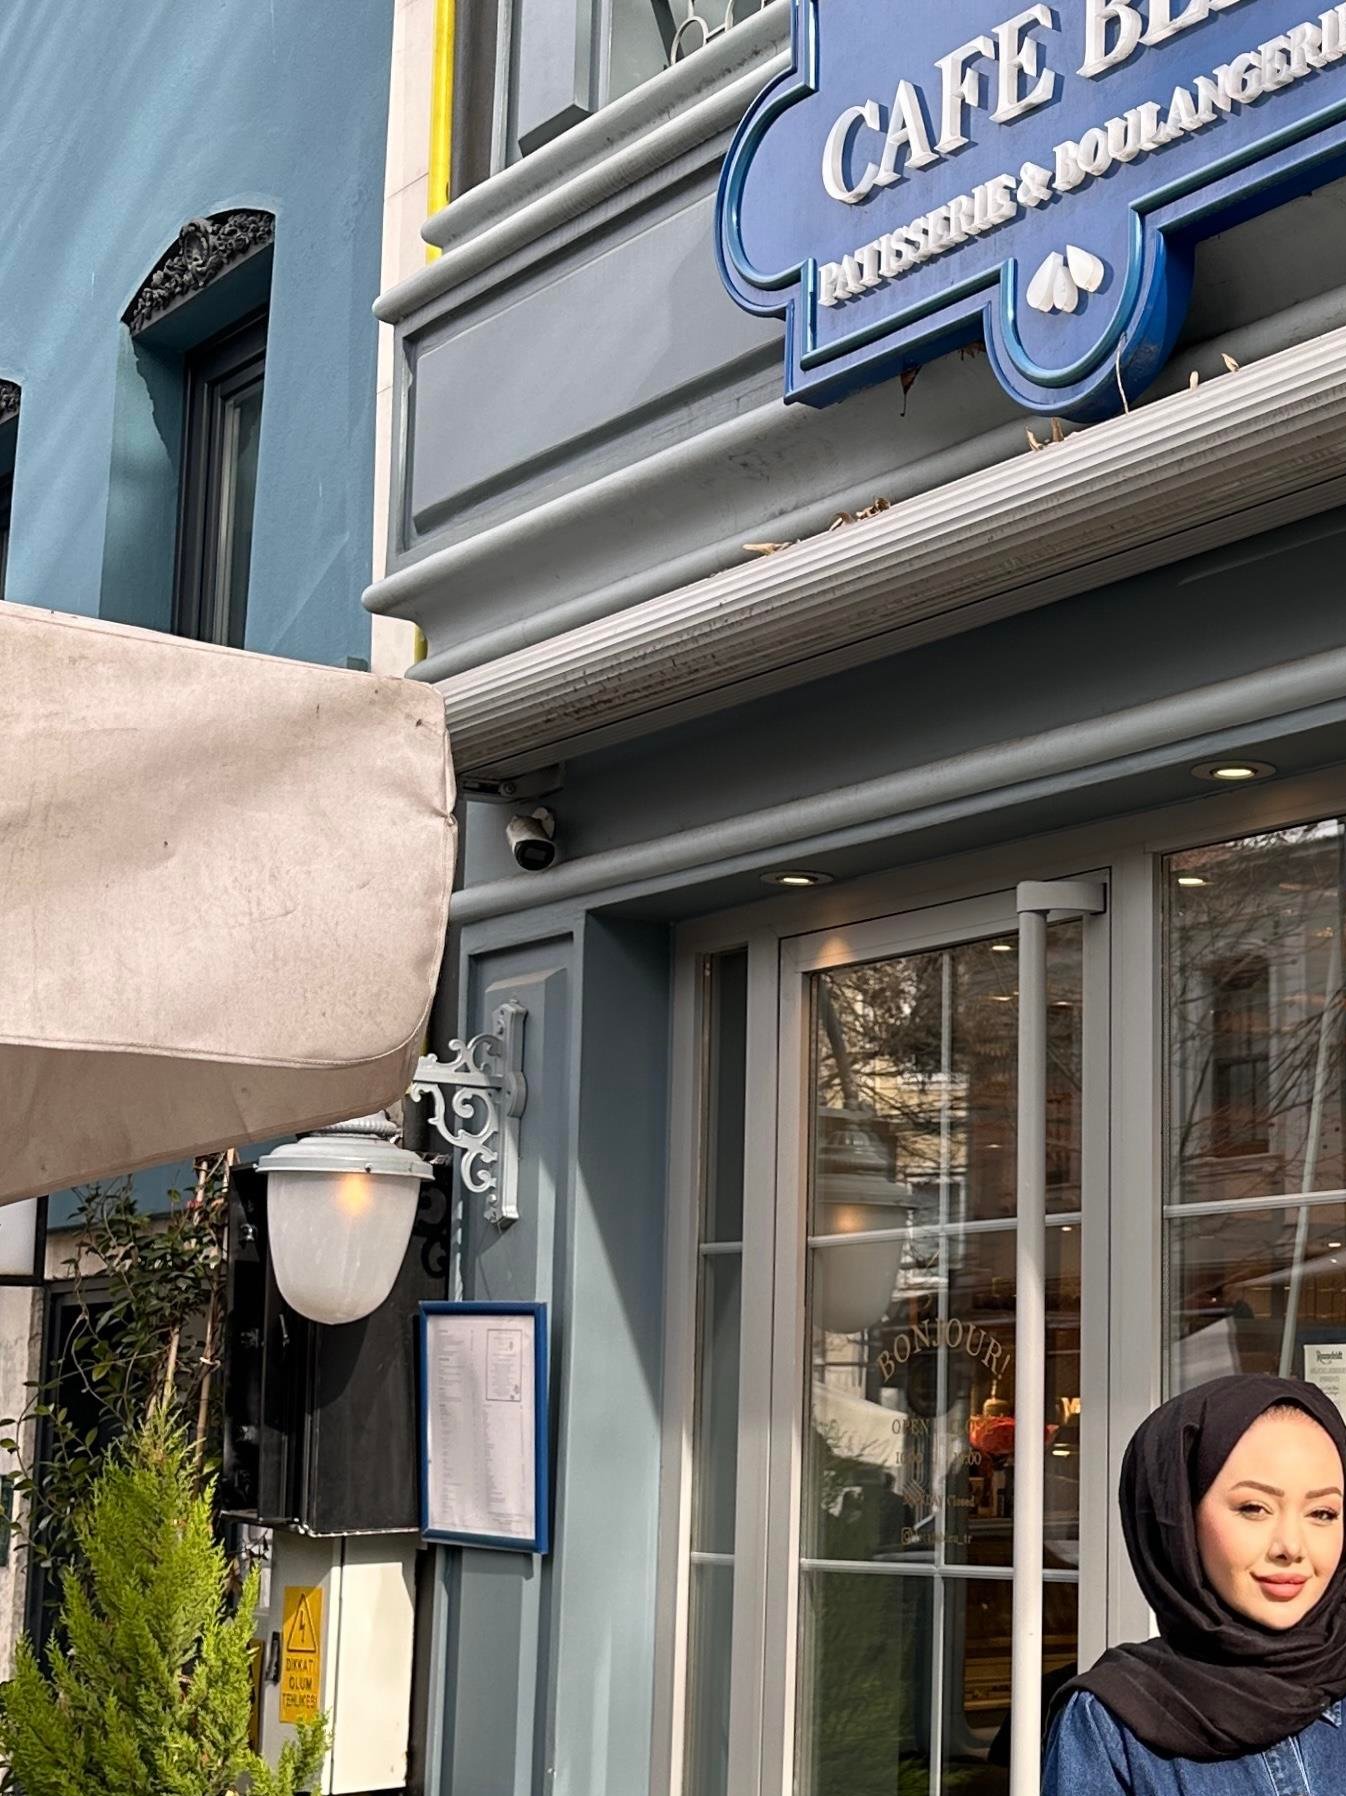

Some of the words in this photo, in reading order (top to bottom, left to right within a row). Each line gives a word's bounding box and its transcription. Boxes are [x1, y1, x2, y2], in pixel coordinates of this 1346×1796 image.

[822, 4, 1063, 204] CAFE
[1077, 0, 1241, 78] BL
[818, 173, 1017, 307] PATISSERIE
[1016, 161, 1054, 208] &
[877, 1317, 1011, 1383] BONJOUR!
